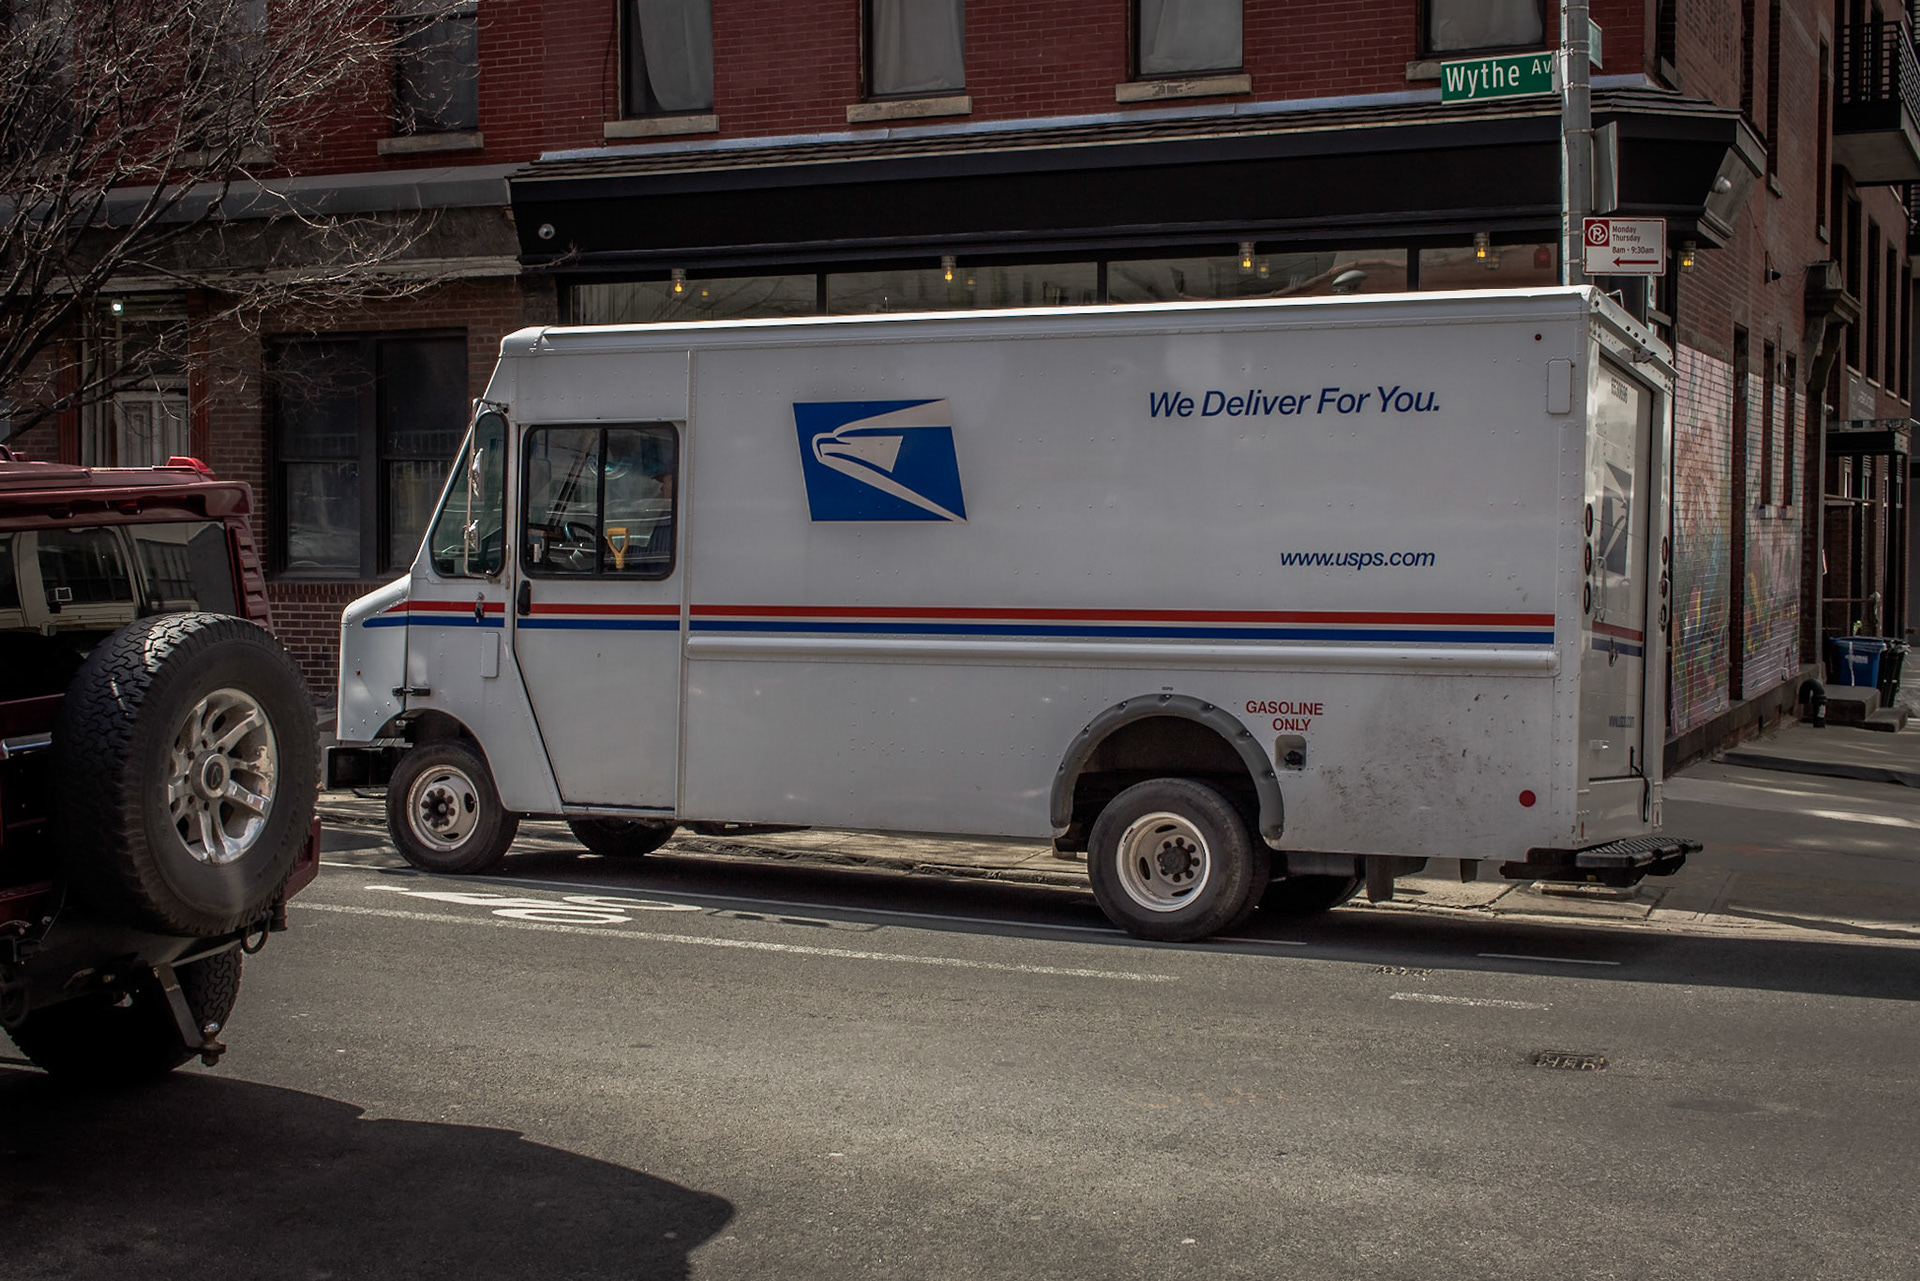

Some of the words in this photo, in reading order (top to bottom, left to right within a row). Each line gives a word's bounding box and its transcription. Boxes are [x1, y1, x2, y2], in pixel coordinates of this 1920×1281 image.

[1445, 60, 1520, 98] Wythe
[1531, 58, 1552, 75] Av
[1612, 226, 1637, 234] Monday
[1612, 234, 1641, 242] Thursday
[1612, 246, 1625, 254] 8am
[1631, 246, 1655, 254] 9:30am
[1150, 391, 1195, 418] We
[1200, 389, 1312, 417] Deliver
[1317, 387, 1371, 415] For
[1376, 385, 1441, 413] You.
[1280, 551, 1436, 571] www.usps.com
[1245, 700, 1324, 716] GASOLINE
[1272, 717, 1312, 731] ONLY
